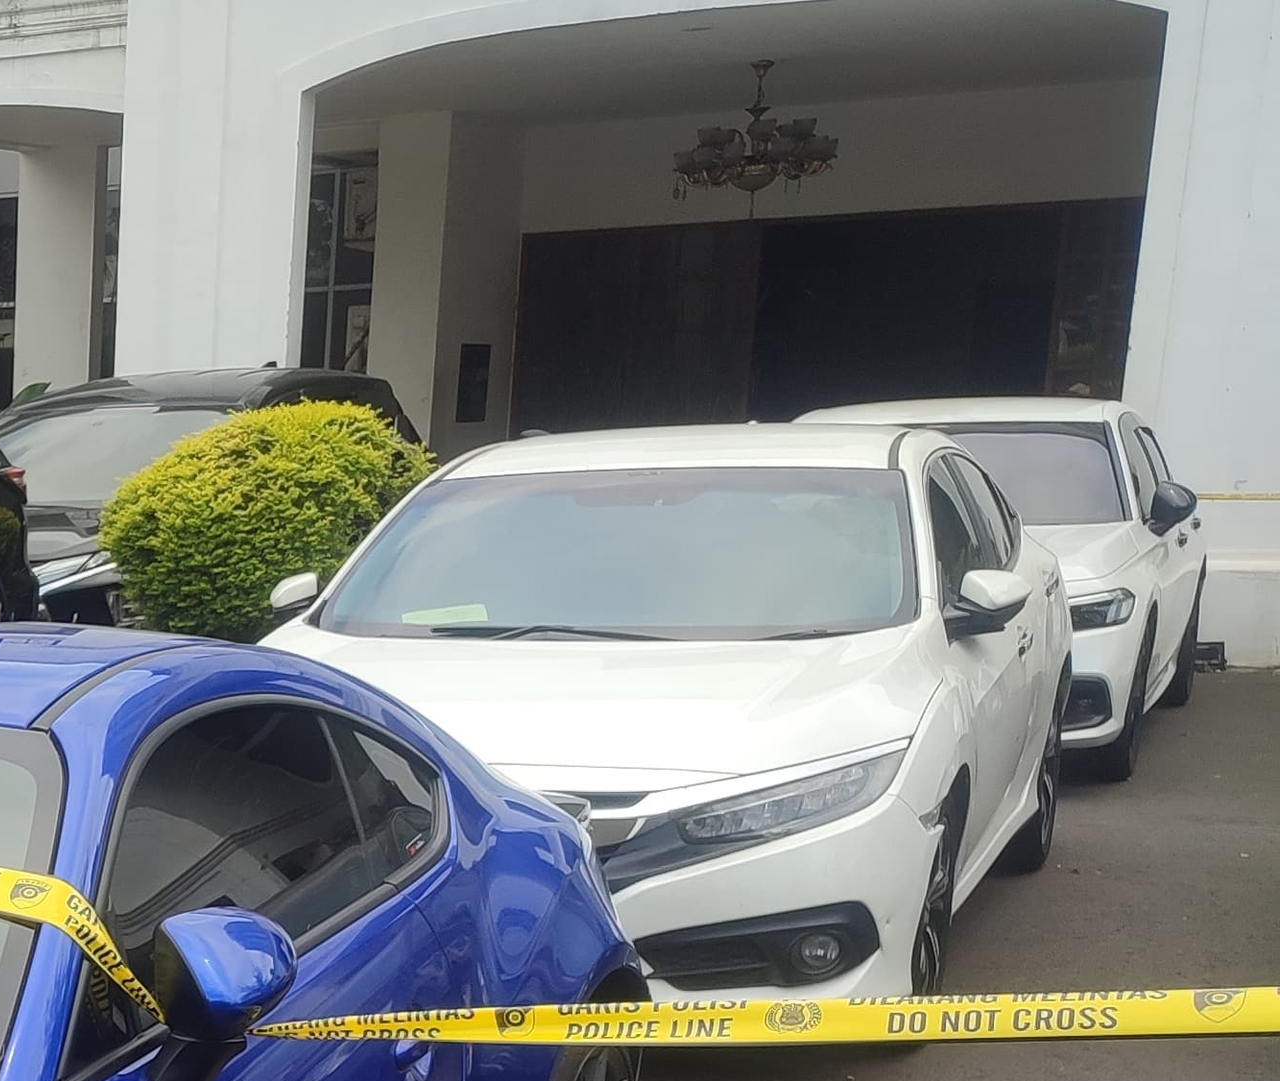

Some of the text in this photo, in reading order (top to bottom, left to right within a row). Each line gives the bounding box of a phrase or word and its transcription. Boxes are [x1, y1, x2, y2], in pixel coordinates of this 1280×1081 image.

[64, 914, 125, 976] POLICE
[565, 1018, 734, 1039] POLICE LINE
[887, 1006, 1119, 1034] DO NOT CROSS
